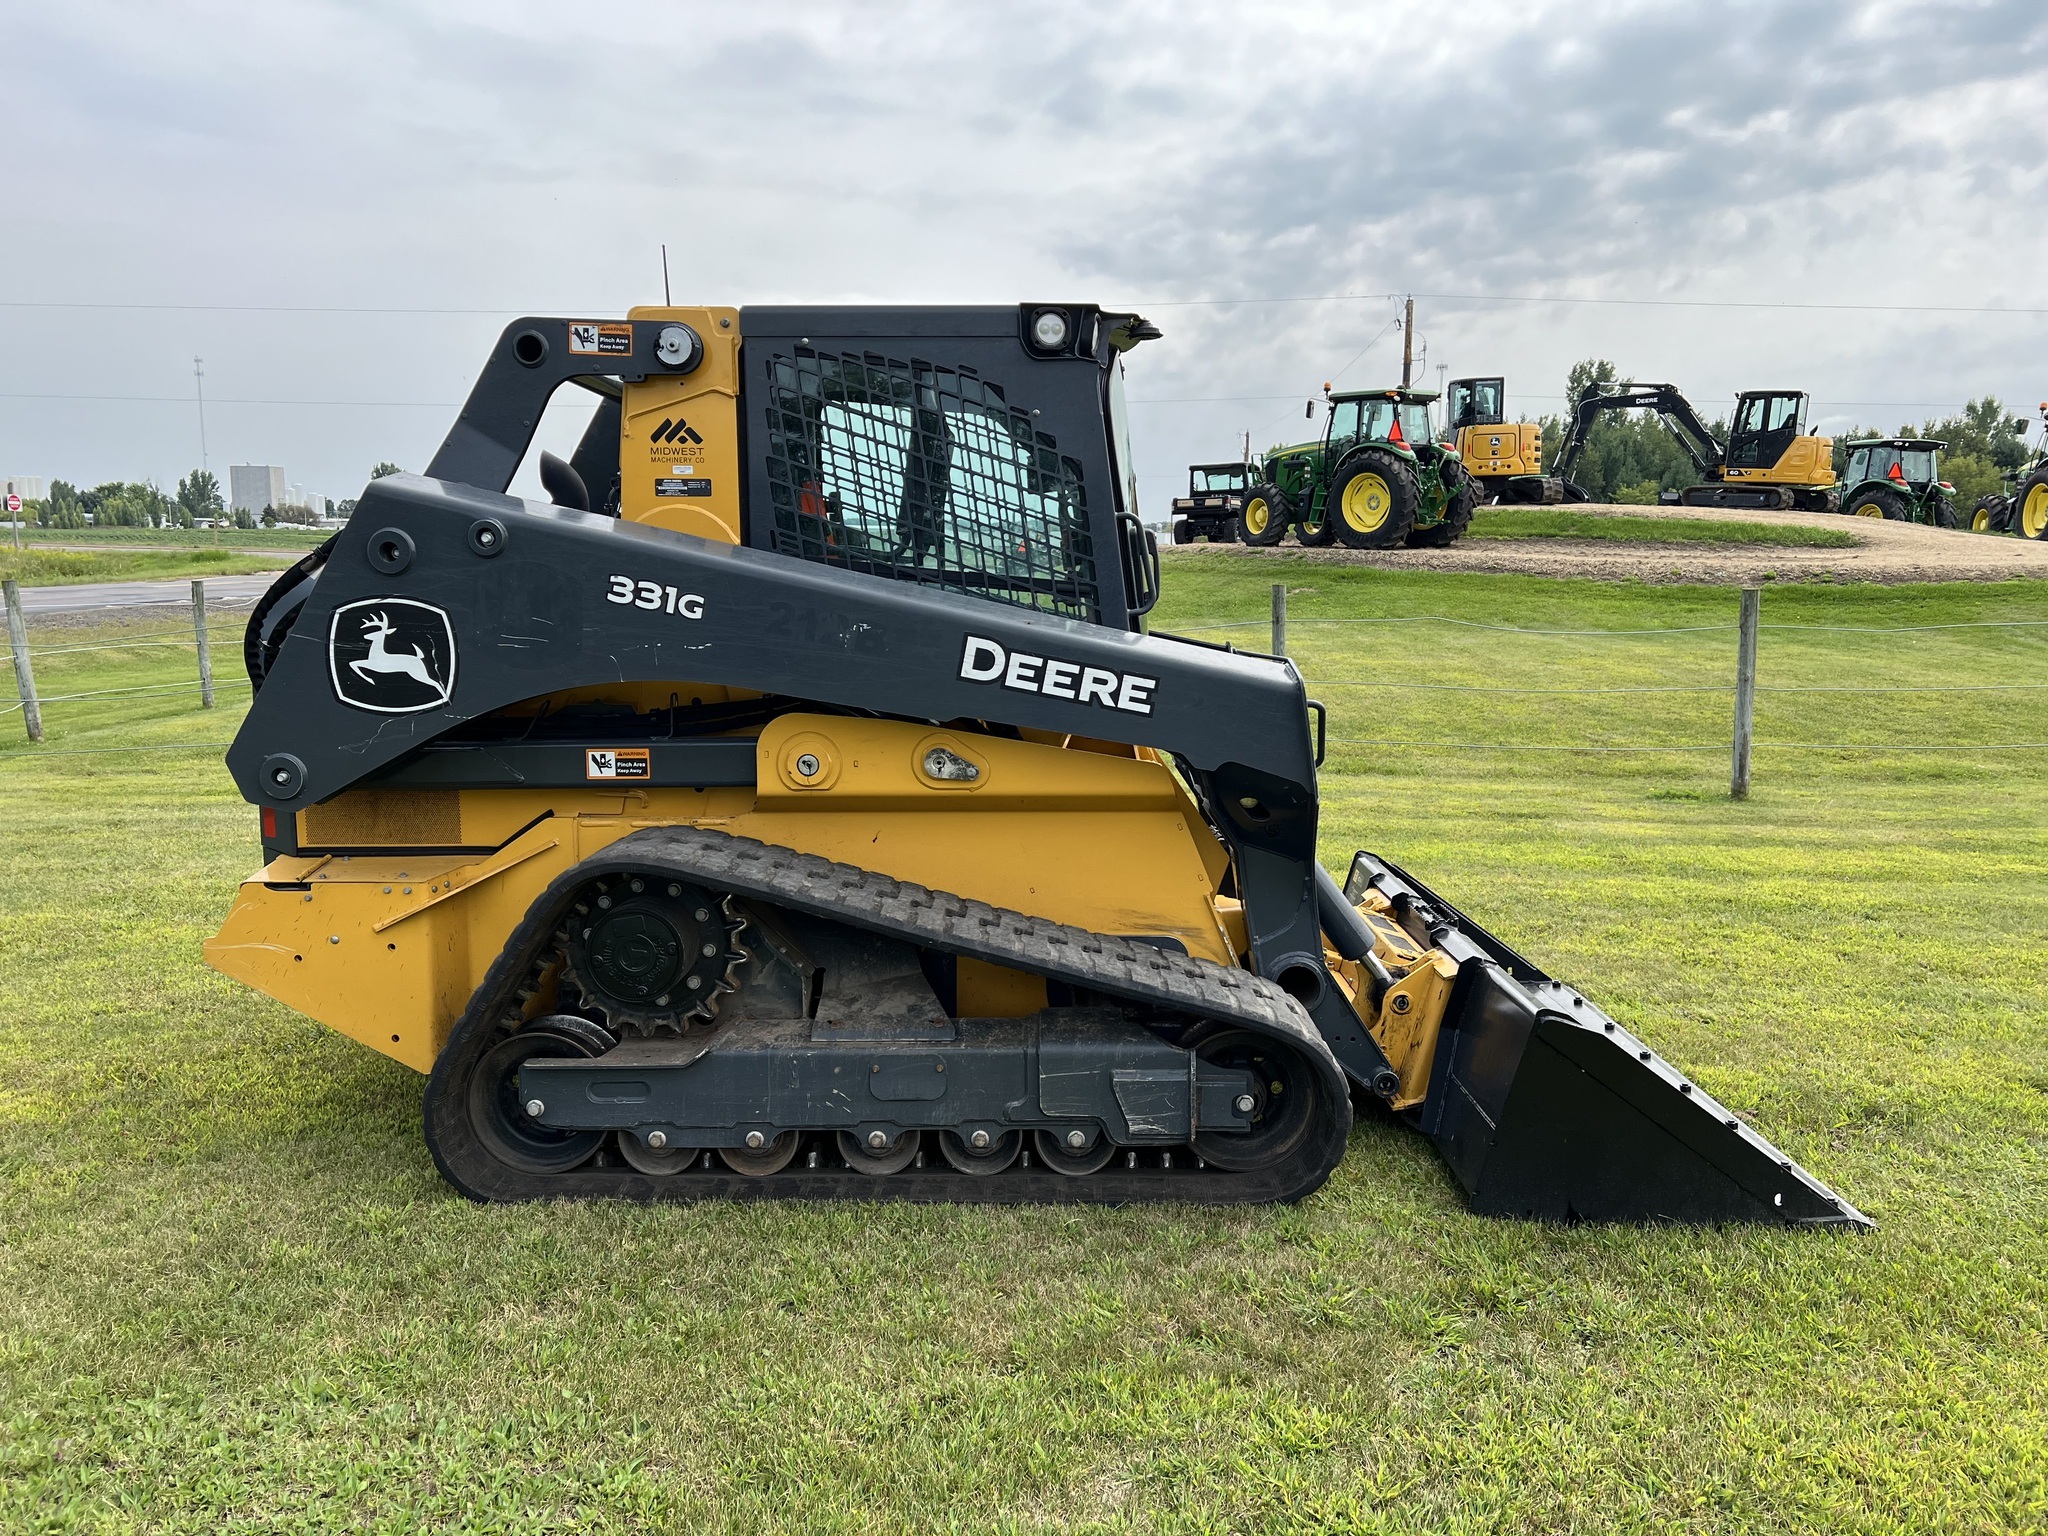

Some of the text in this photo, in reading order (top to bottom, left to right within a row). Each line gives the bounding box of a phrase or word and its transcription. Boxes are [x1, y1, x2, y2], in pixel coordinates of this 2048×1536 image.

[650, 447, 705, 456] MIDWEST
[650, 456, 705, 464] MACHINERY CO
[606, 575, 705, 619] 331G
[960, 635, 1157, 715] DEERE
